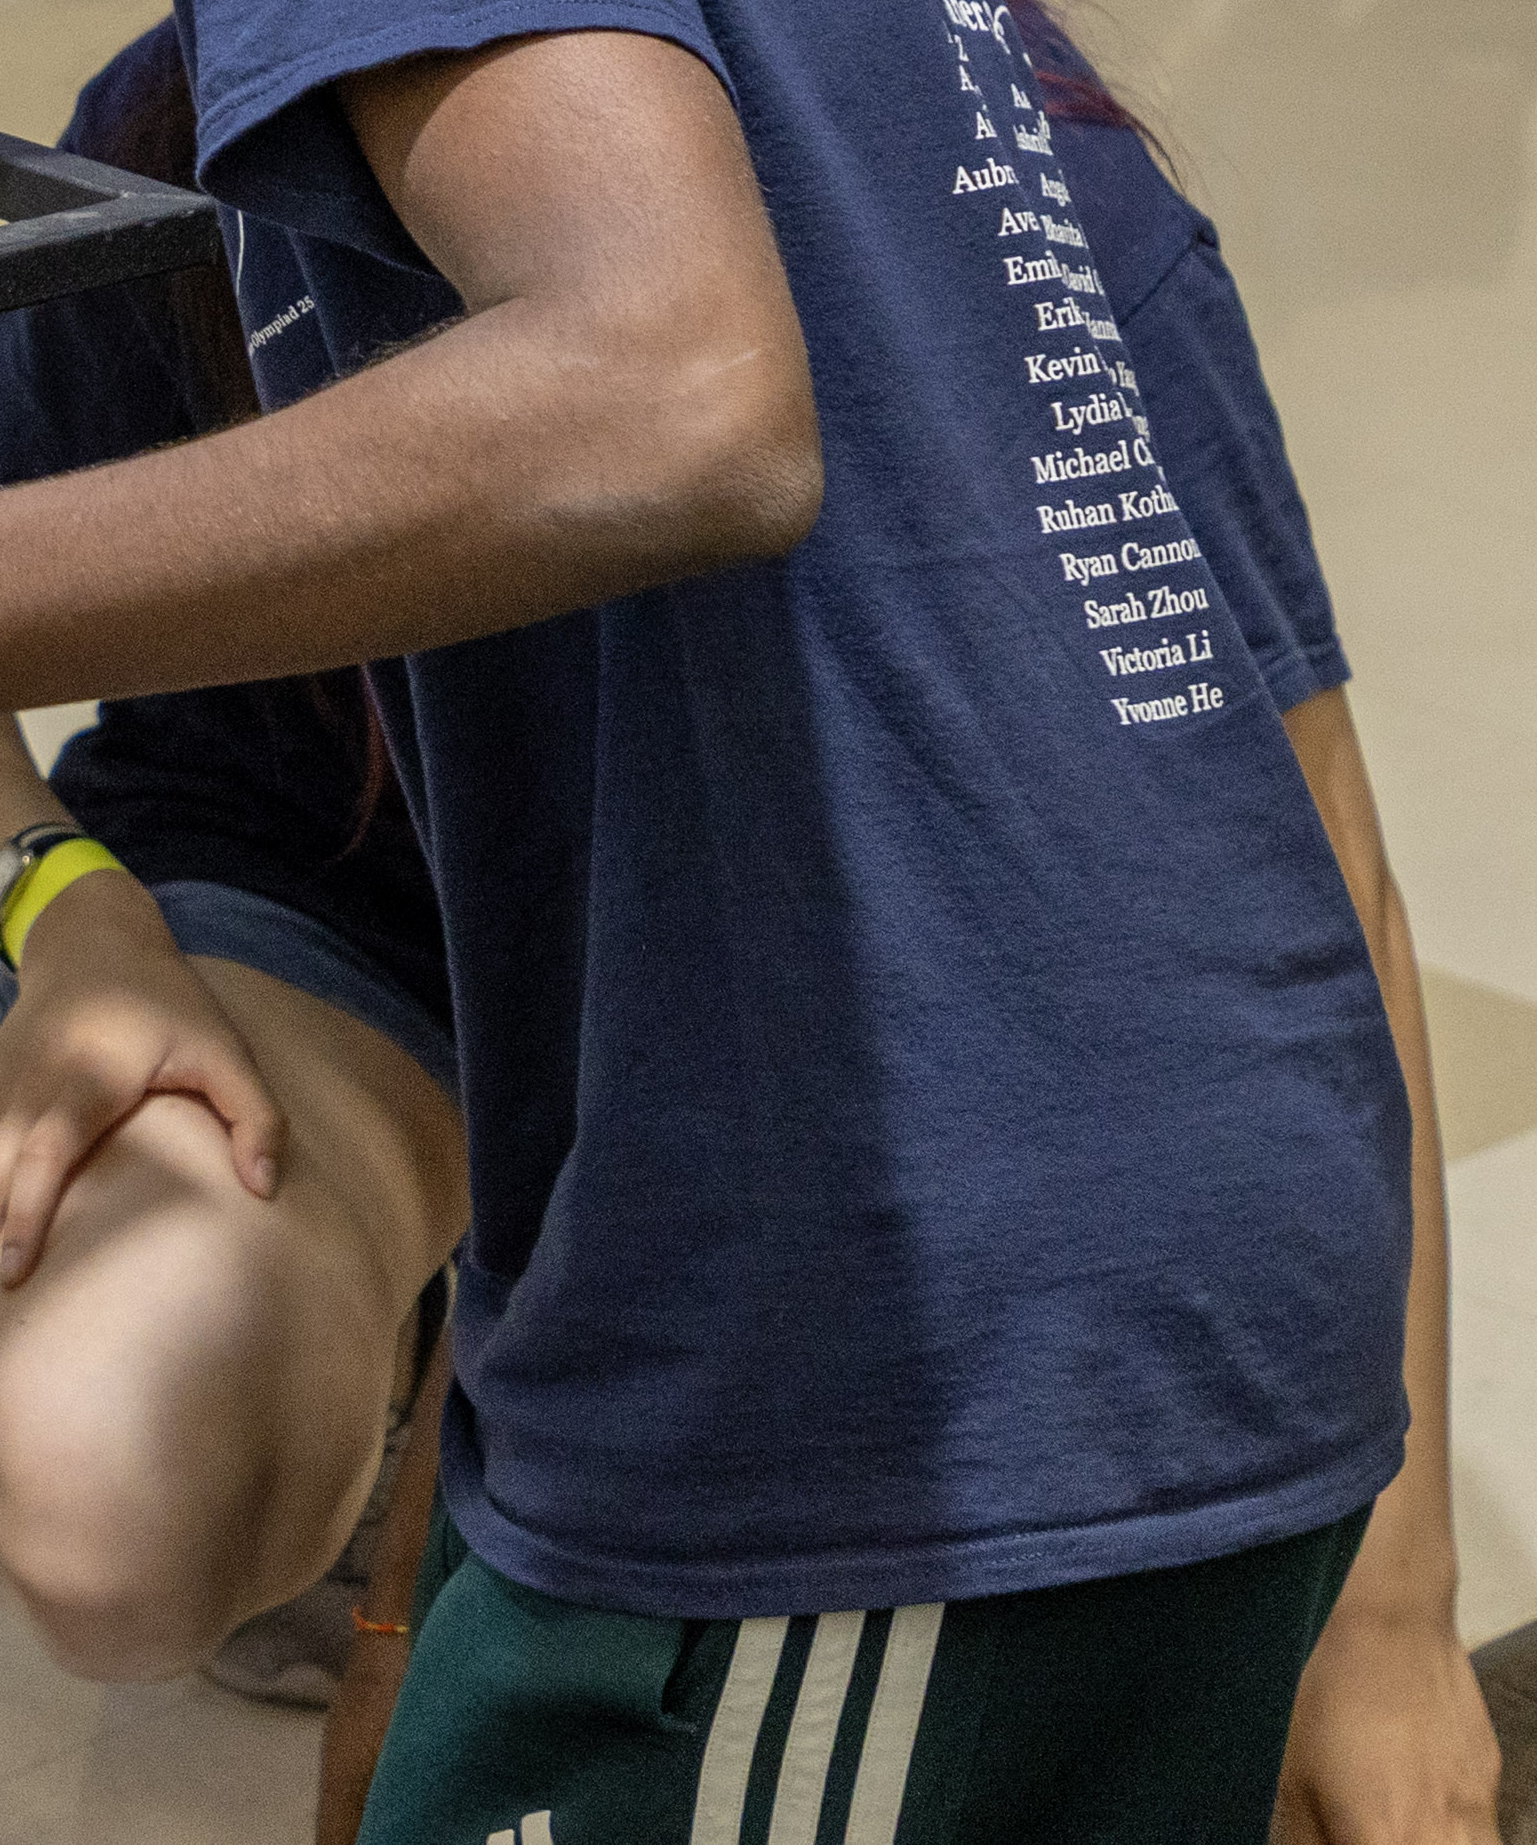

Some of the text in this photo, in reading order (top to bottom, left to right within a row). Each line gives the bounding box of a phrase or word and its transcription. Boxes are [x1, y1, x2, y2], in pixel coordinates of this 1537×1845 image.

[251, 295, 315, 349] Olympiad 25
[1023, 346, 1101, 384] Kevin
[1050, 393, 1124, 435] Lydia
[1030, 440, 1132, 484] Michael
[1036, 500, 1117, 534] Ruhan
[1059, 553, 1119, 587] Ryan
[1084, 585, 1210, 629] Sarah Zhou
[1099, 629, 1214, 677] Victoria Li
[1110, 682, 1224, 726] Yvonne He
